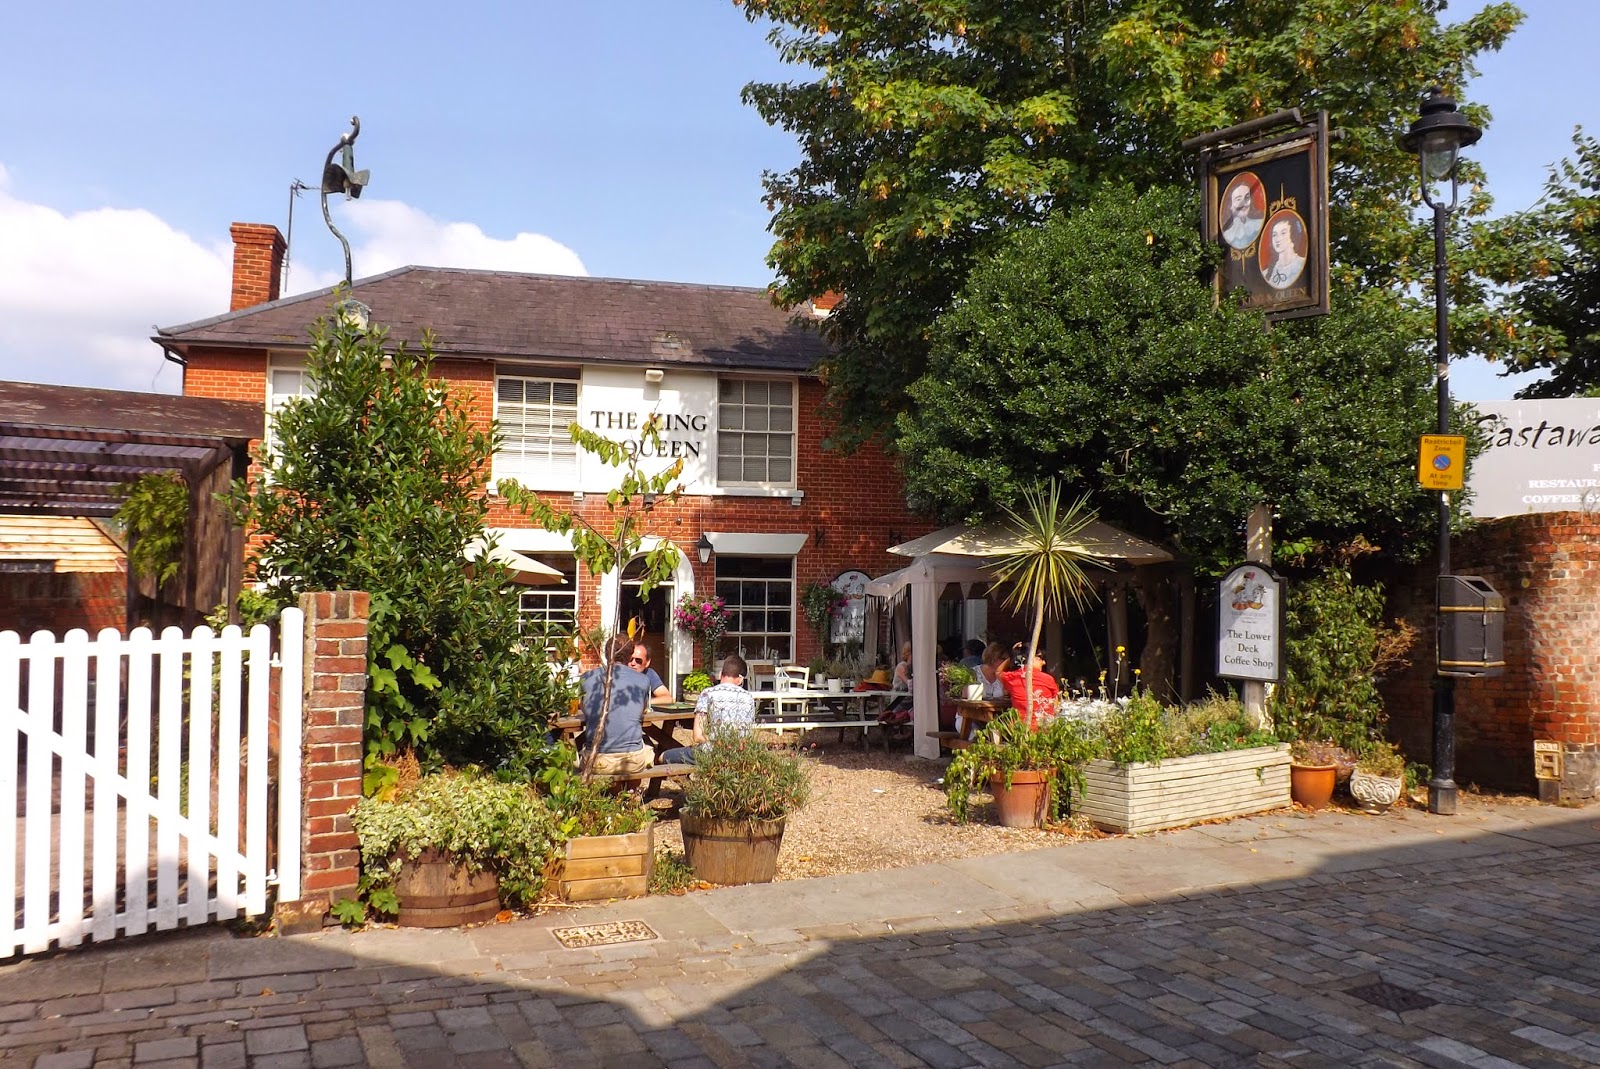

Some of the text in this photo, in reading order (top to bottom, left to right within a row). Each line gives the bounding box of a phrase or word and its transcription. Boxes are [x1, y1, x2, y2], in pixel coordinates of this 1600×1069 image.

[1275, 287, 1306, 299] QUEEN
[590, 411, 637, 429] THE
[622, 439, 700, 458] QUEEN
[1522, 494, 1581, 504] COFFEE
[1227, 629, 1271, 641] The Lower
[1238, 643, 1259, 653] Deck
[1224, 655, 1273, 669] Coffee Shop
